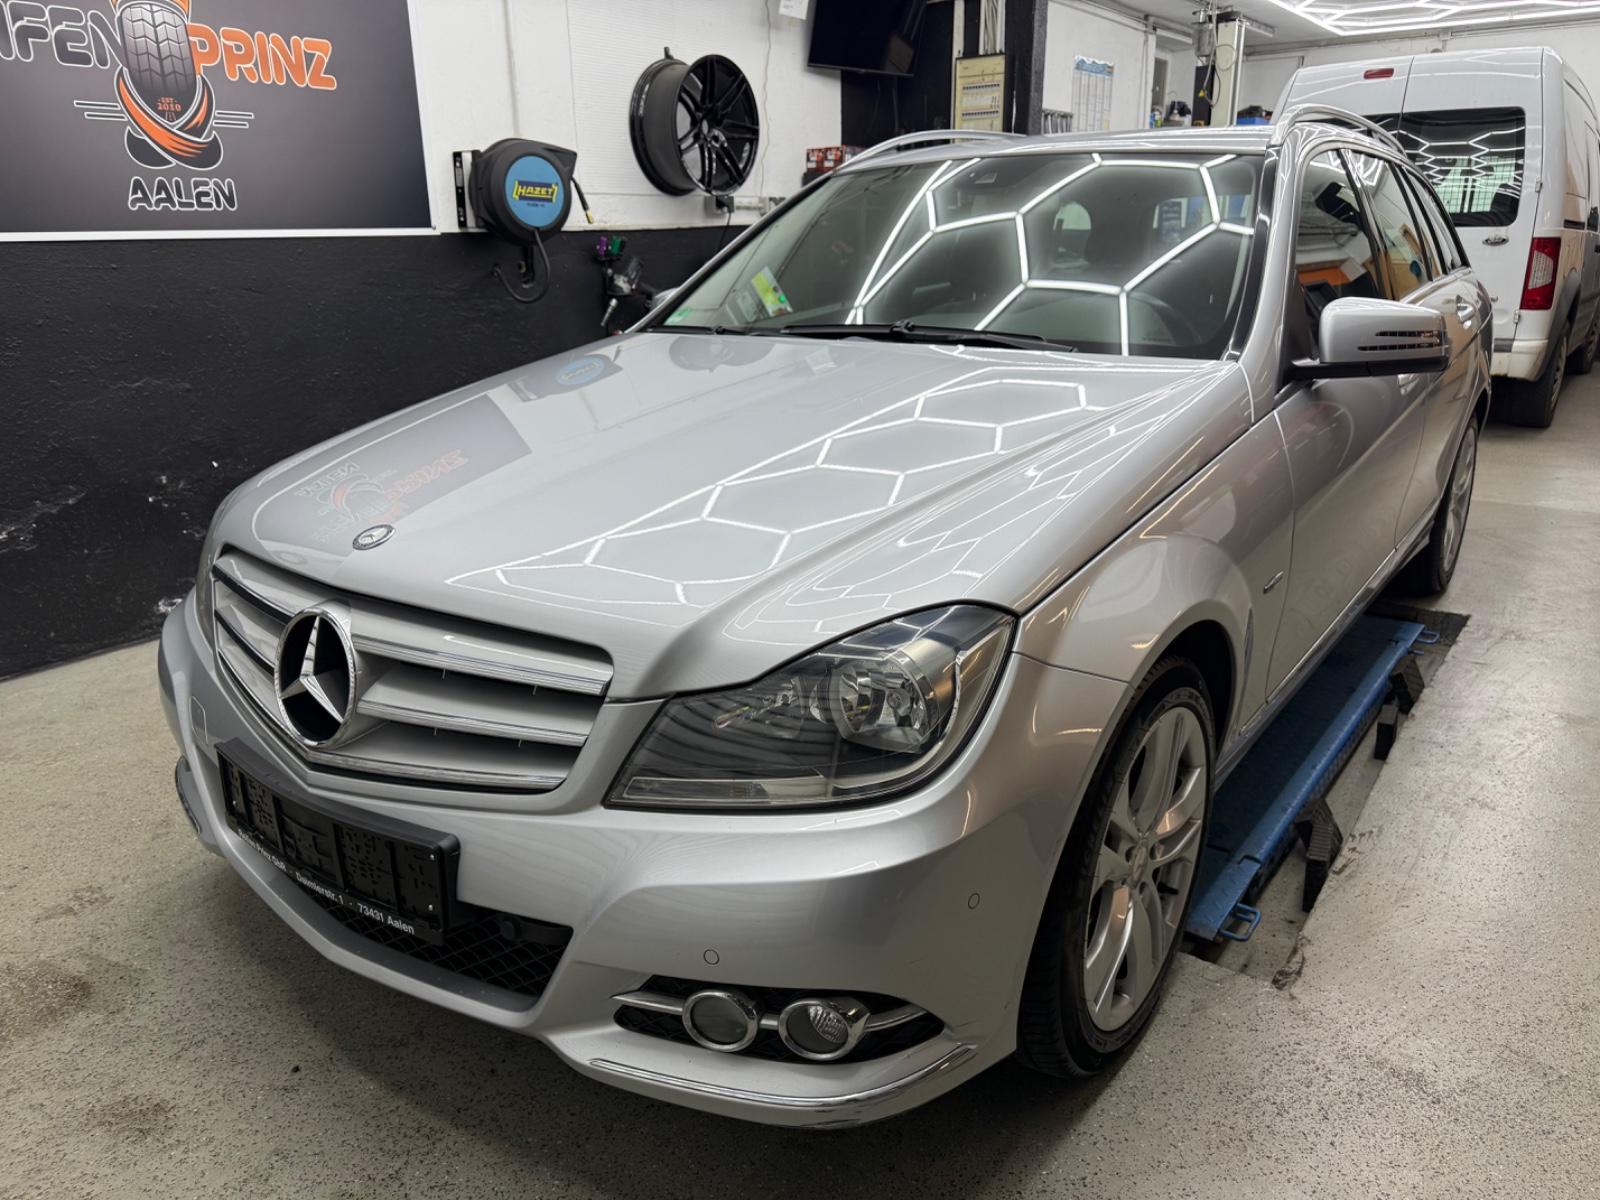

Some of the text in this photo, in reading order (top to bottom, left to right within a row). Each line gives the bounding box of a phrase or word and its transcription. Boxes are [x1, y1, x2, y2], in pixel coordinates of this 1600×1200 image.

[187, 23, 337, 90] PRINZ
[157, 102, 182, 112] 2010
[128, 176, 237, 211] AALEN
[517, 184, 553, 197] HAZET
[357, 902, 385, 923] 73431
[387, 915, 415, 935] Aalen
